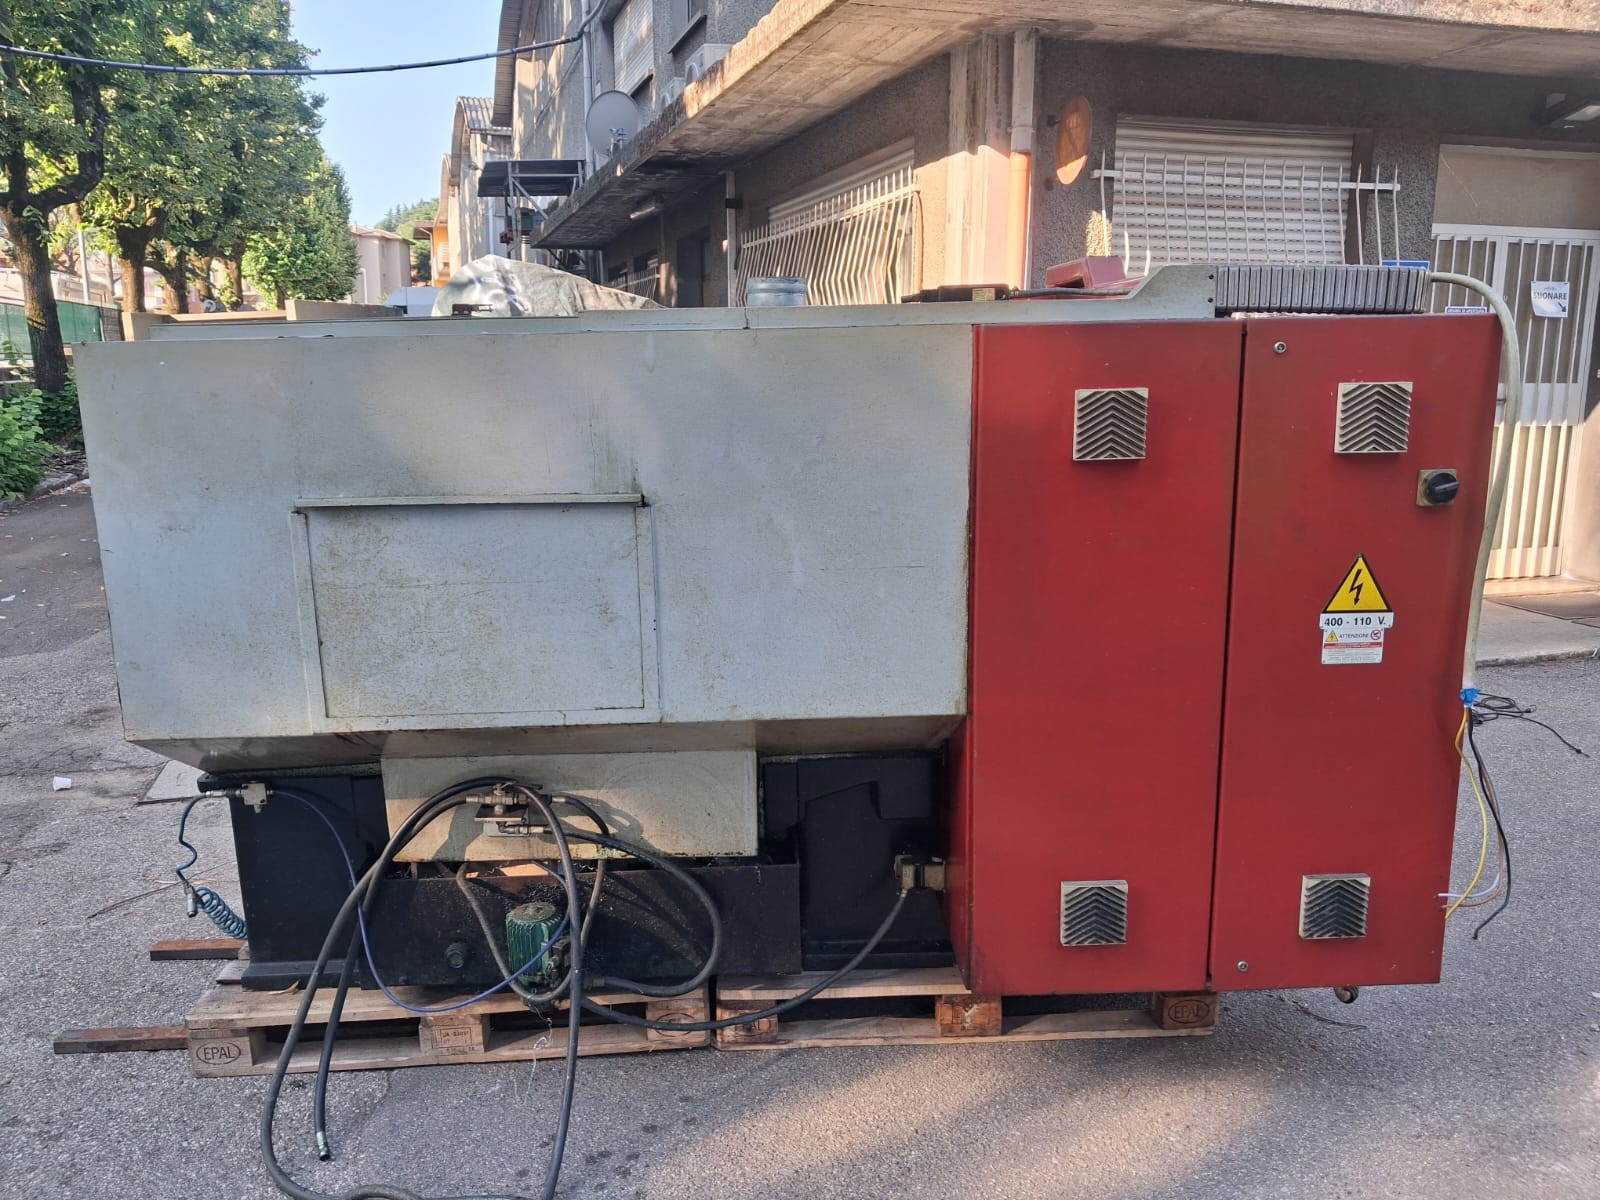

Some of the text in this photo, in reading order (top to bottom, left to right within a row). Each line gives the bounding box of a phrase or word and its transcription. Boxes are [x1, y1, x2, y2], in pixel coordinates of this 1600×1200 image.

[1324, 617, 1343, 626] 400
[1354, 616, 1372, 626] 110
[1378, 616, 1386, 625] V.
[203, 1046, 236, 1060] EPAL
